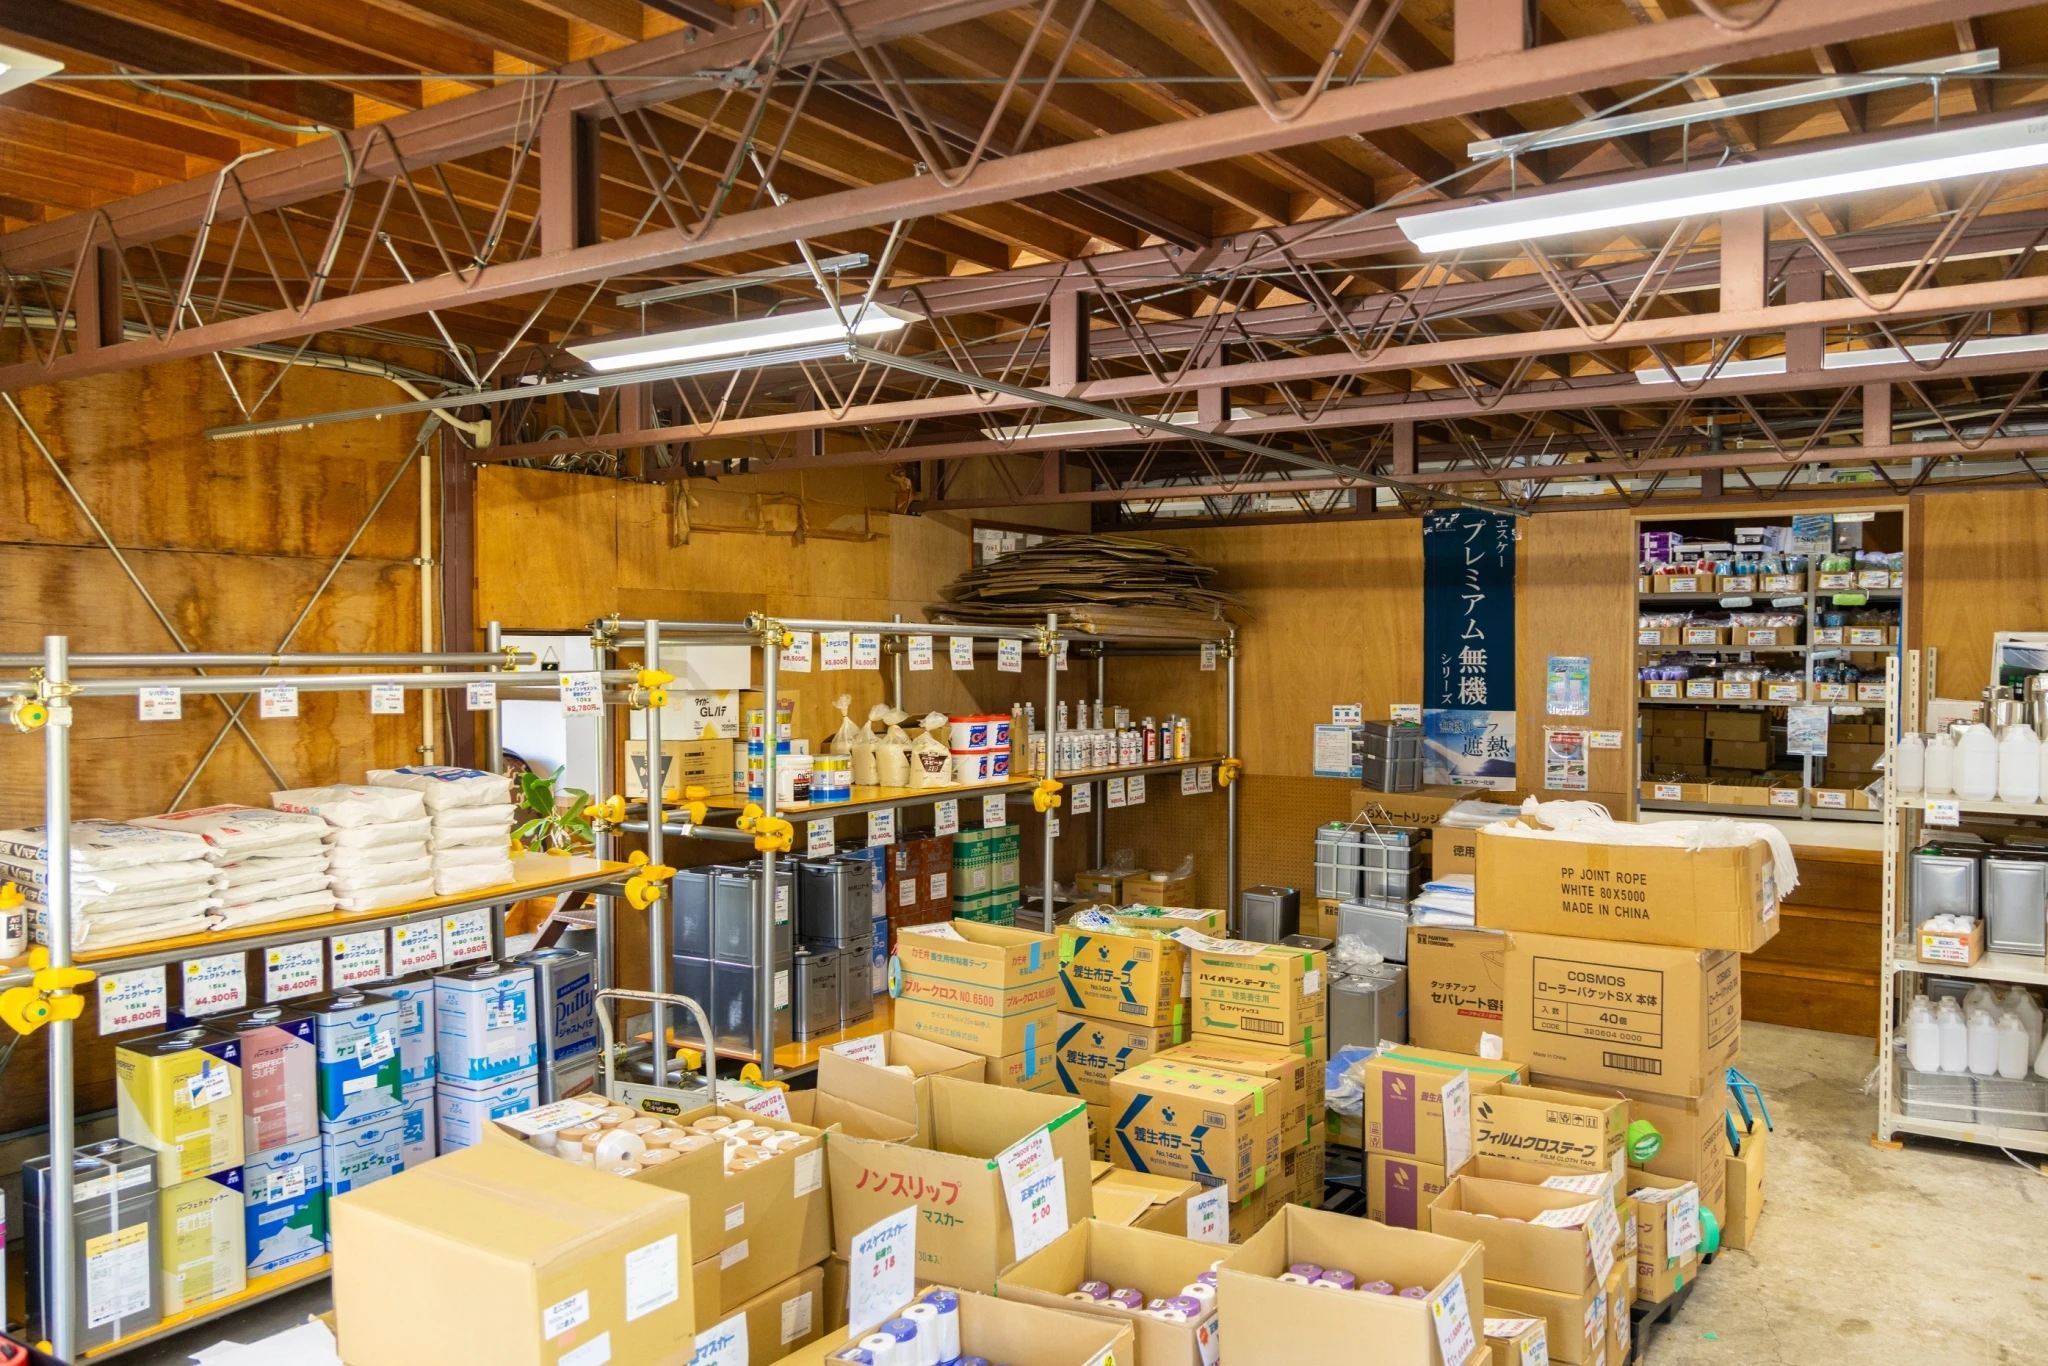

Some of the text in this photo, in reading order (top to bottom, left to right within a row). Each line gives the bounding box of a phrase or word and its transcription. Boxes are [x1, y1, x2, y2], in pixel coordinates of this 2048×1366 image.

[1496, 519, 1508, 567] エスケー
[1457, 519, 1488, 705] プレミアム無機
[1441, 653, 1452, 704] シリーズ
[1439, 719, 1499, 733] 無機ルーフ
[1461, 735, 1510, 757] 遮熱
[1453, 845, 1475, 858] 徳用
[1561, 867, 1647, 886] PP JOINT ROPE
[1561, 883, 1646, 903] WHITE 80X5000
[1562, 901, 1650, 920] MADE IN CHINA
[460, 921, 474, 929] ニッペ
[351, 943, 367, 951] ニッペ
[453, 943, 488, 956] ¥9,980円
[286, 953, 303, 962] ニッペ
[401, 952, 437, 966] ¥9,900円
[911, 948, 988, 970] カモ井 養生用布粘着テープ
[1012, 956, 1027, 967] カモ井
[187, 969, 242, 983] パーフェクトフィラー
[206, 964, 223, 973] ニッペ
[343, 967, 380, 981] ¥8,900円
[1073, 964, 1132, 987] 養生布テープ
[277, 978, 317, 993] ¥8,400円
[1431, 980, 1476, 993] タッチアップ
[1567, 971, 1626, 987] COSMOS
[105, 987, 163, 1003] パーフェクトサーフ
[124, 983, 144, 992] ニッペ
[904, 980, 994, 1008] ブルークロス NO.6500
[1090, 984, 1113, 993] No.140A
[1538, 981, 1658, 1007] ローラーバケットSX 本体
[195, 991, 238, 1007] ¥4,300円
[1007, 991, 1039, 1008] ブルークロス
[1210, 988, 1270, 1004] 塗装・建築養生用
[114, 1009, 161, 1025] ¥5,800円
[555, 989, 593, 1037] Putty
[1599, 1012, 1628, 1025] 40個
[559, 1018, 595, 1038] ジャストパテ
[1541, 1022, 1560, 1030] CODE
[1584, 1027, 1643, 1042] 320604 0000
[253, 1043, 299, 1058] パーフェクトサーフ
[1552, 1053, 1567, 1061] China
[252, 1056, 287, 1071] PERFECT
[1008, 1063, 1024, 1075] カモ井
[252, 1066, 278, 1080] SURF
[1084, 1069, 1107, 1080] No.140A
[1134, 1125, 1205, 1156] 養生布テープ
[1476, 1129, 1597, 1158] フィルムクロステープ
[1156, 1149, 1182, 1161] No.140A
[1540, 1153, 1597, 1167] FILM CLOTH TAPE
[856, 1167, 963, 1206] ノンスリップ
[1020, 1173, 1056, 1203] 正宗マスカー
[176, 1193, 229, 1212] パーフェクトフィラー
[922, 1208, 964, 1228] マスカー
[1031, 1204, 1051, 1225] 2.00
[858, 1222, 908, 1256] サスケマスカー
[872, 1254, 896, 1278] 2.18
